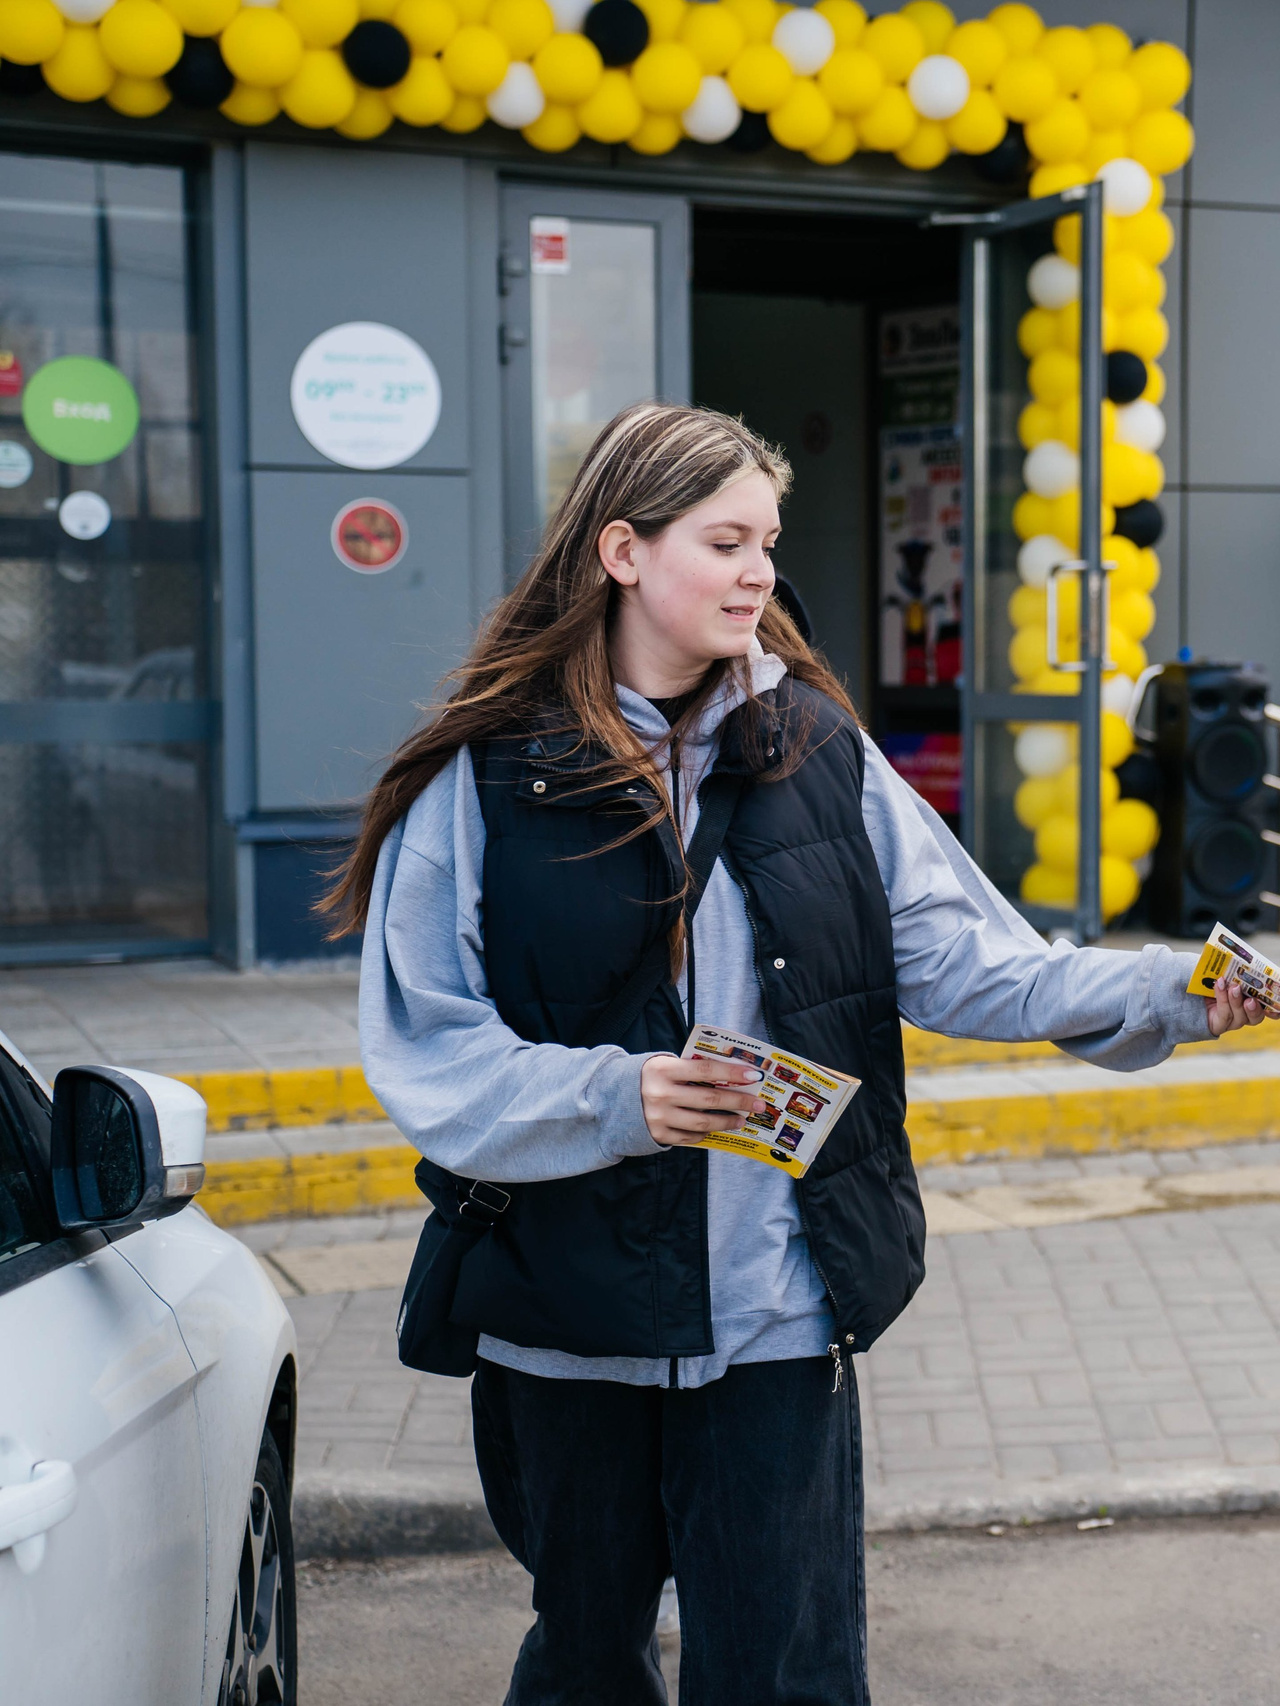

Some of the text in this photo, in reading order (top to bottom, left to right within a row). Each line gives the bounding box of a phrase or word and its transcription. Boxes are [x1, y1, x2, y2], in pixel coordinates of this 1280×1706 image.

[53, 398, 112, 422] Вход
[720, 1035, 762, 1050] ЧИЖИК
[777, 1055, 802, 1069] ОЧЕНЬ
[802, 1067, 833, 1087] ВКУСНО!
